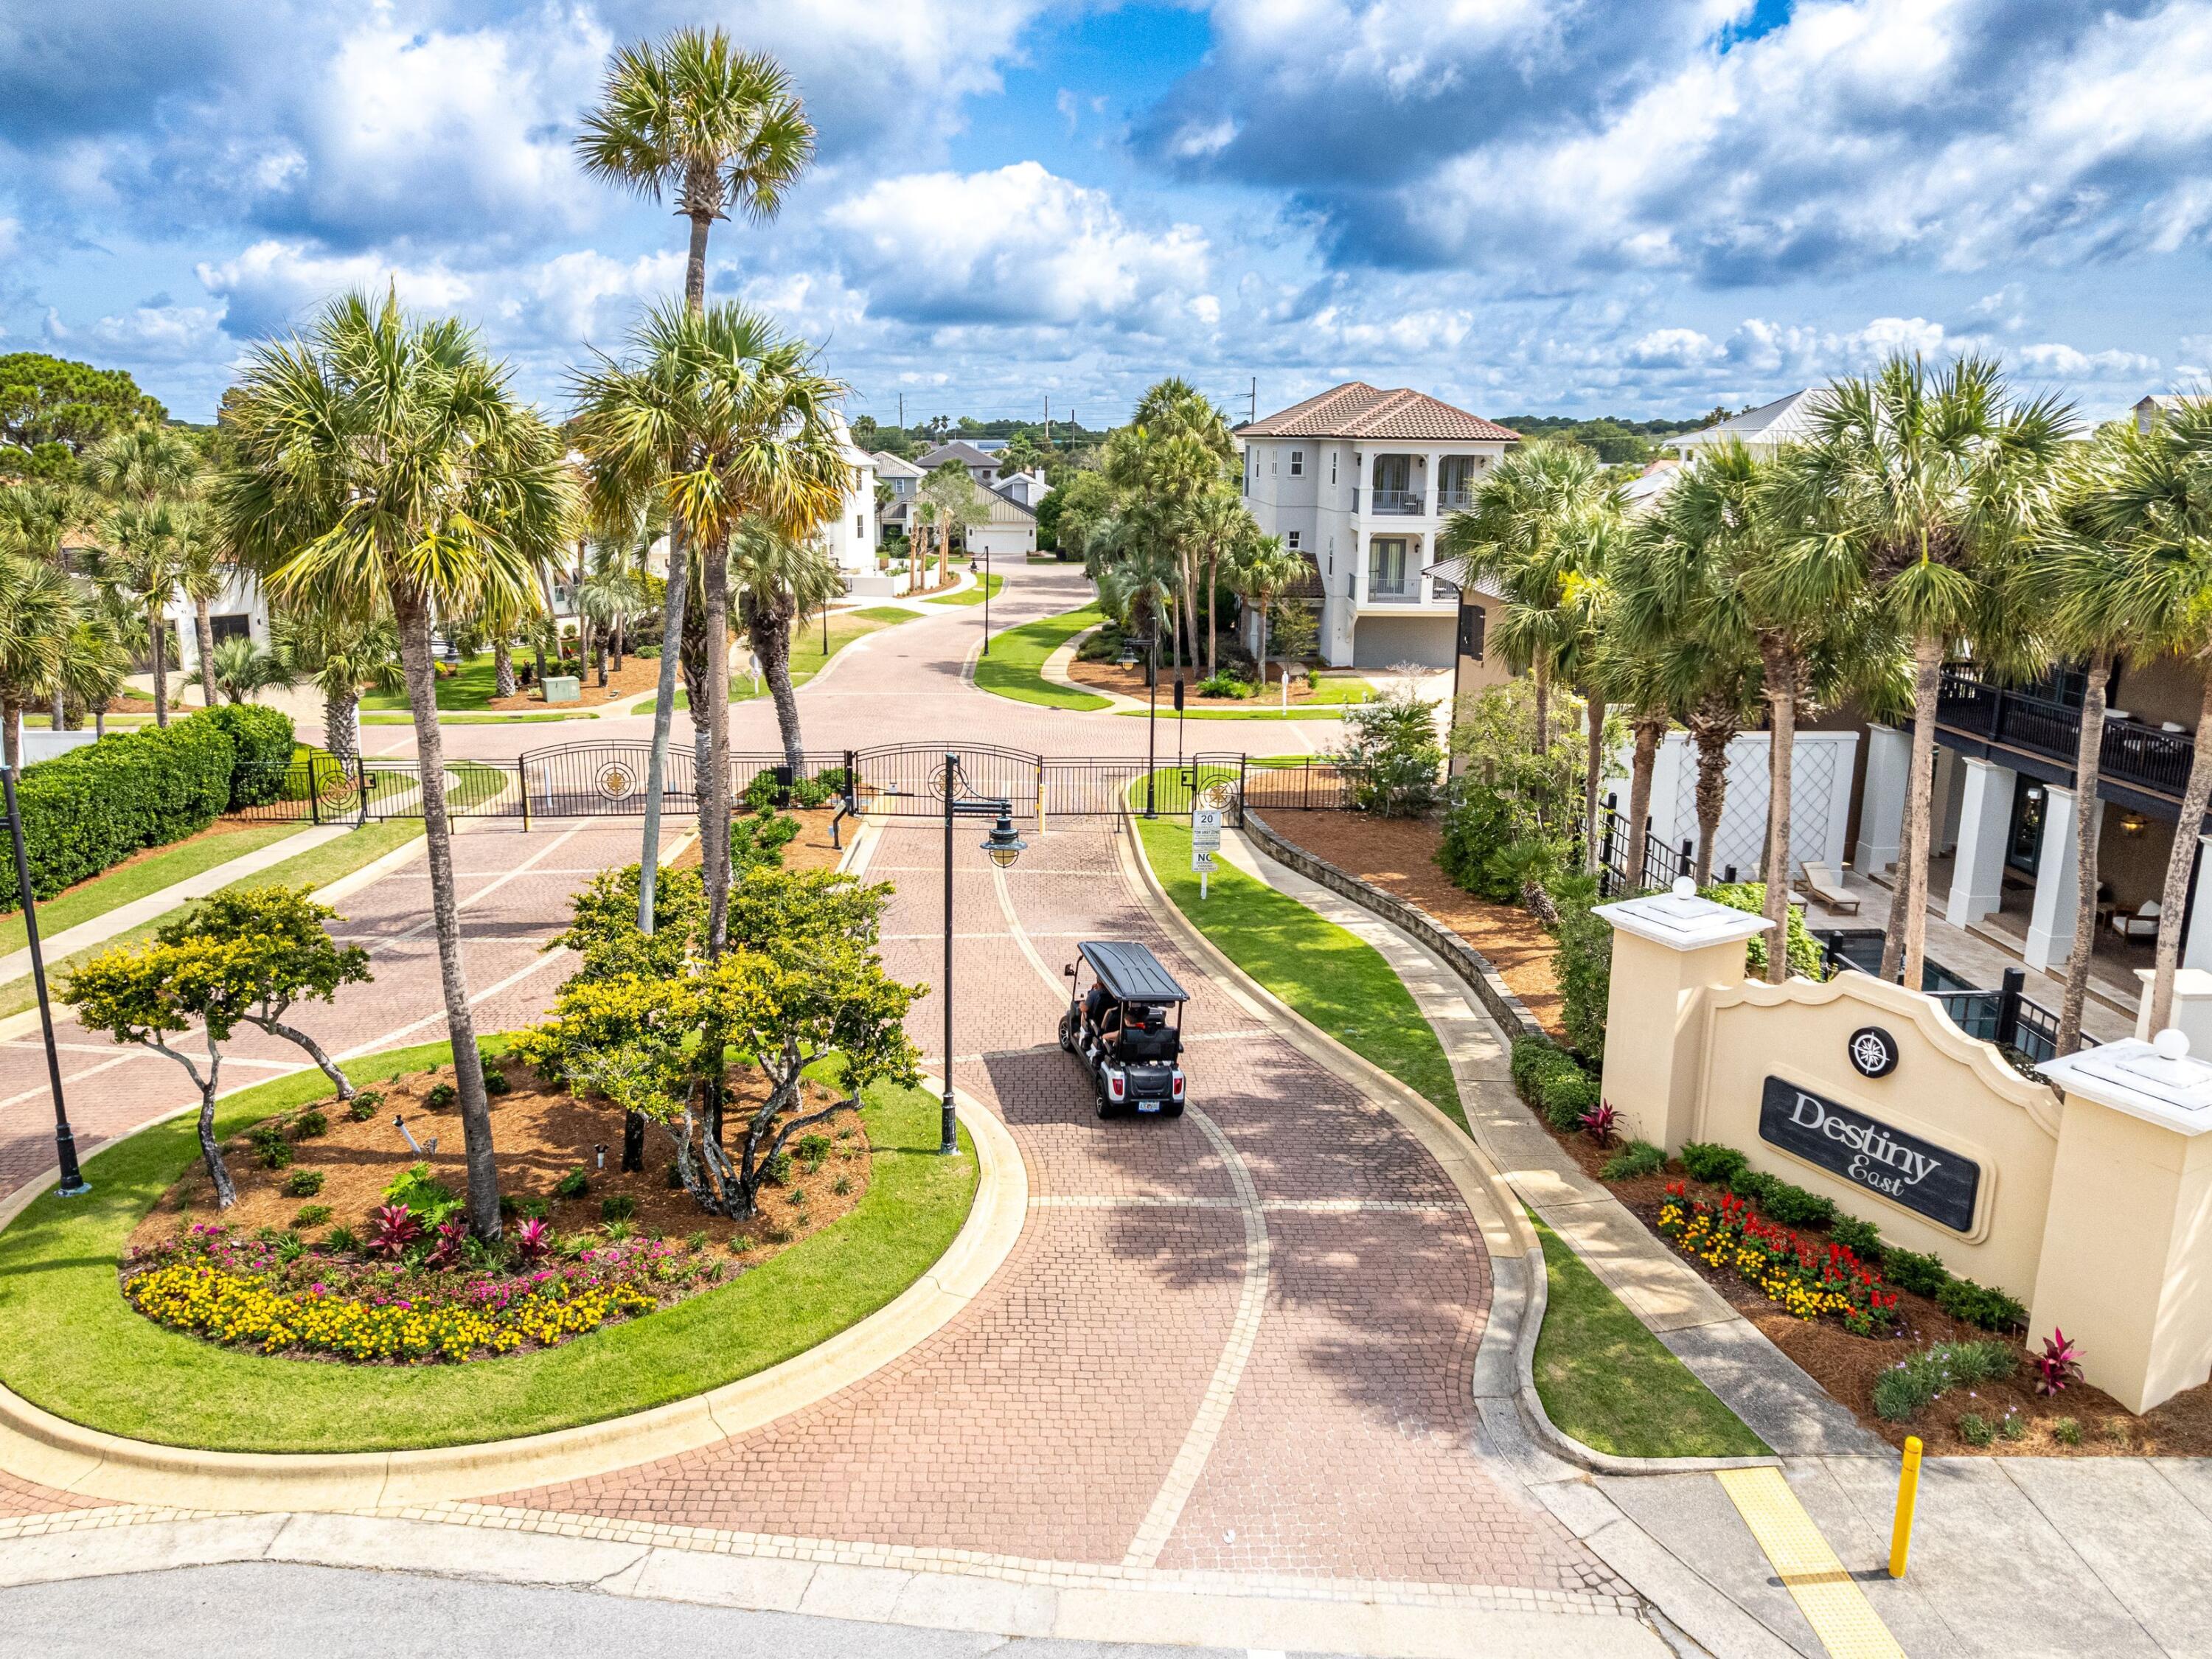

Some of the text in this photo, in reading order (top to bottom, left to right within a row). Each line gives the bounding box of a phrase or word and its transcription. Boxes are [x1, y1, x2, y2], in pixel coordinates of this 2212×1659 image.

[1201, 815, 1213, 823] 20
[1789, 1092, 1941, 1186] Destiny
[1848, 1155, 1905, 1197] East
